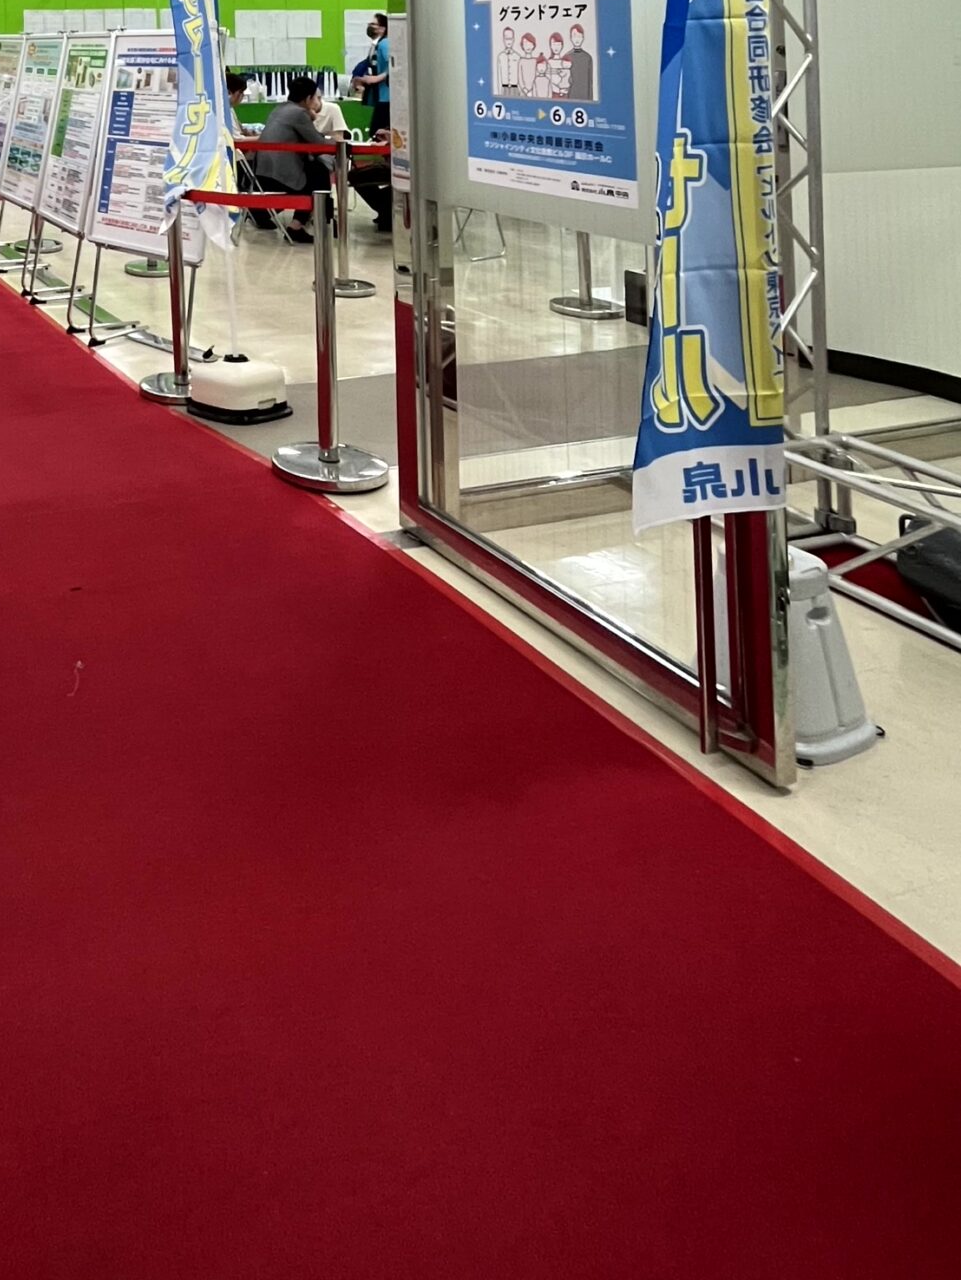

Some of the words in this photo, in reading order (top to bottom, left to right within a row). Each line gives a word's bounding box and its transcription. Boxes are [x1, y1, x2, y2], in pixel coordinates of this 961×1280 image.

[498, 3, 587, 21] グランドフェア
